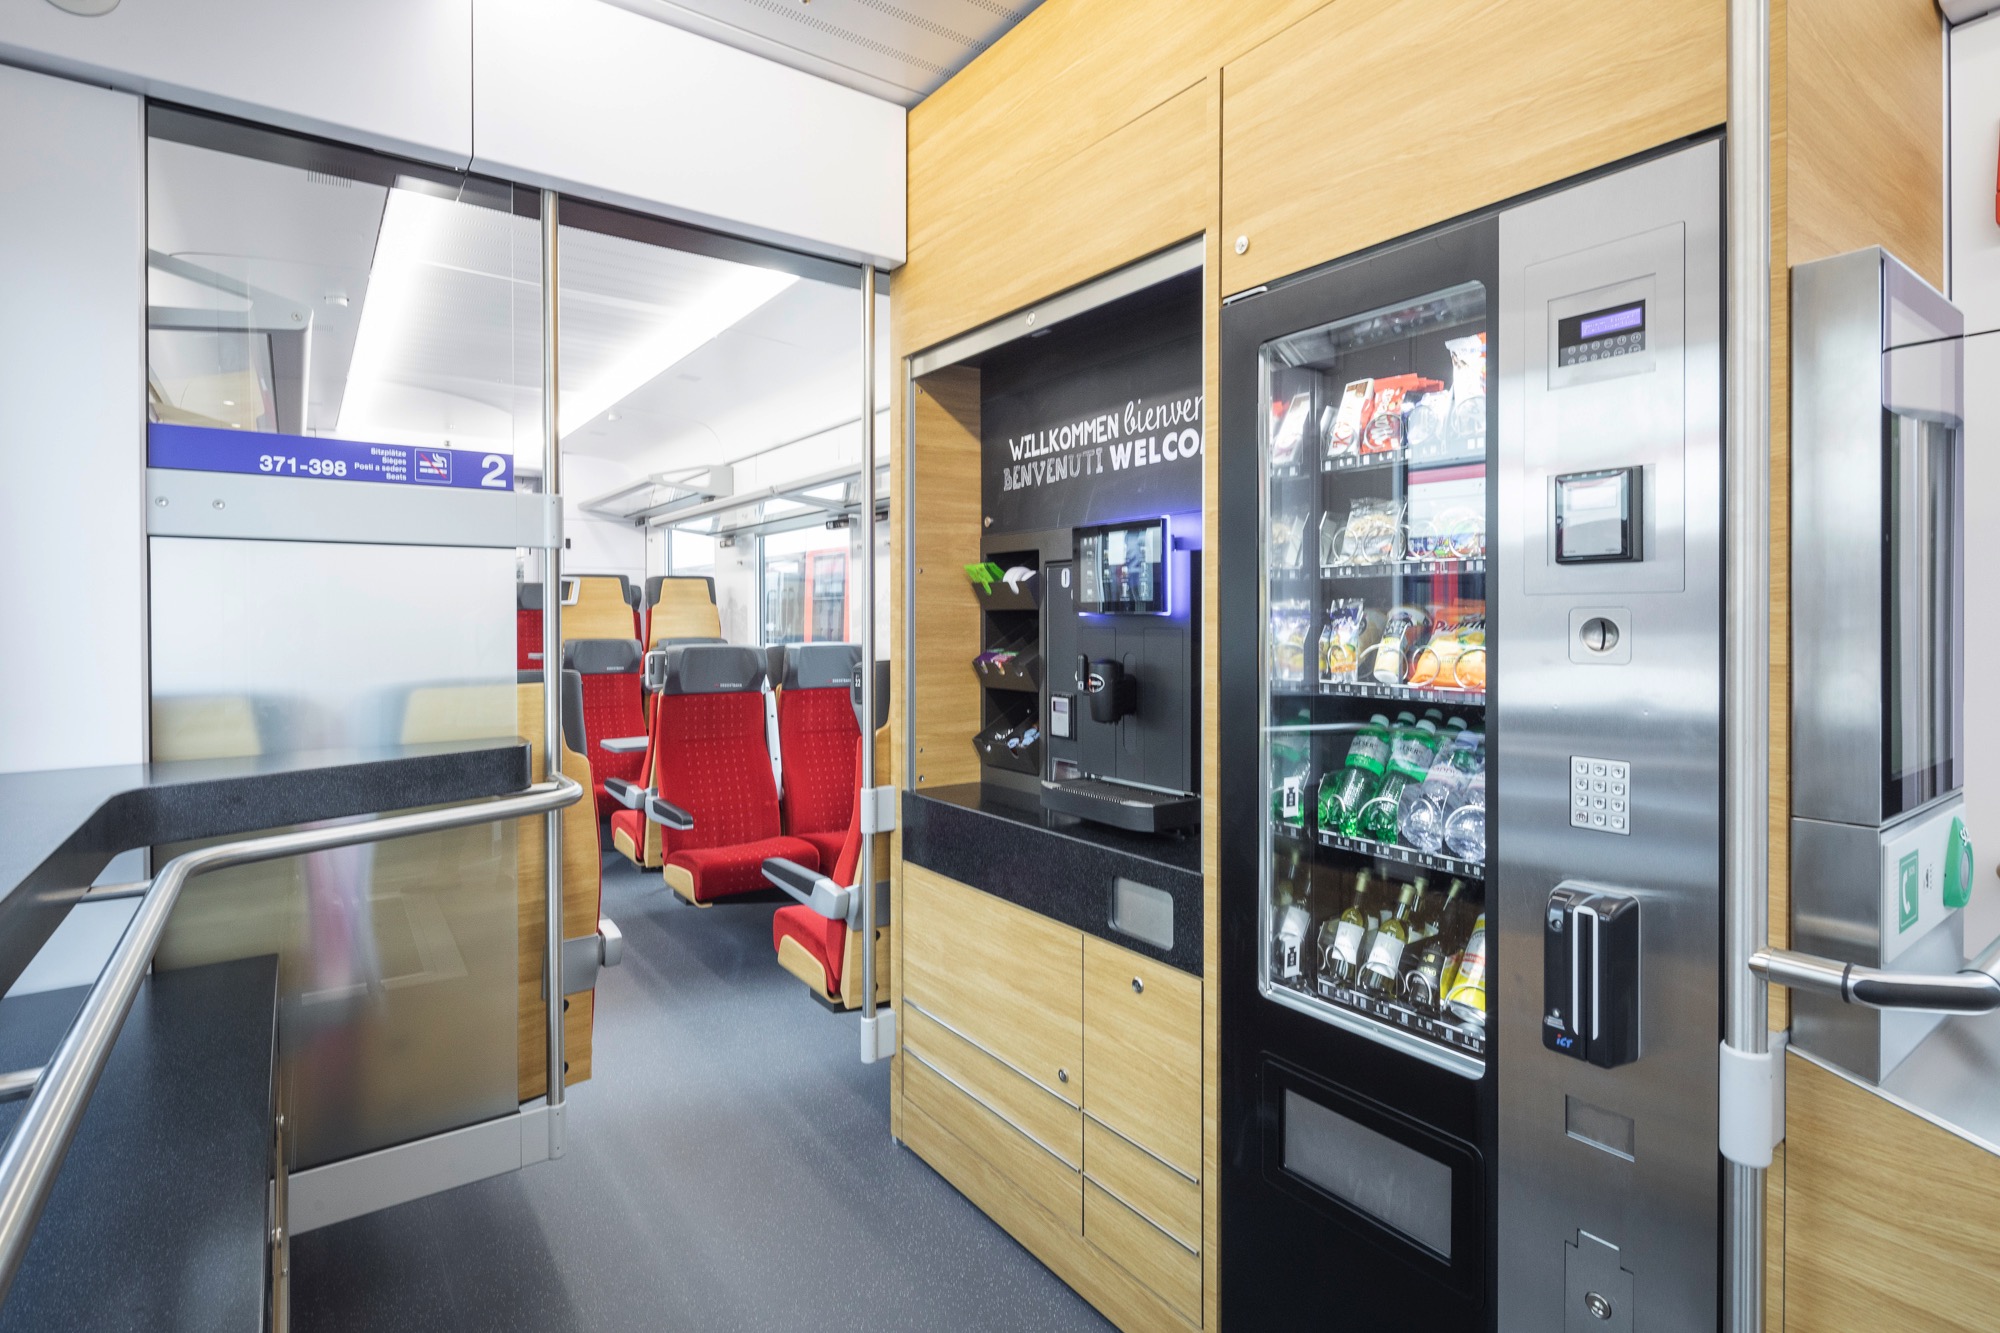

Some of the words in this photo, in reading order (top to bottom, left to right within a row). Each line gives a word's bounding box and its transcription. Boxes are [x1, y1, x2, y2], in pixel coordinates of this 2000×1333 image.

[1008, 412, 1120, 462] WILLKOMMEN
[259, 455, 347, 477] 371-398
[354, 461, 374, 471] Posti
[381, 465, 407, 473] sedere
[481, 454, 508, 488] 2
[1003, 447, 1104, 492] BENVENUTI
[1109, 427, 1204, 471] WELCO
[386, 472, 407, 481] Seats
